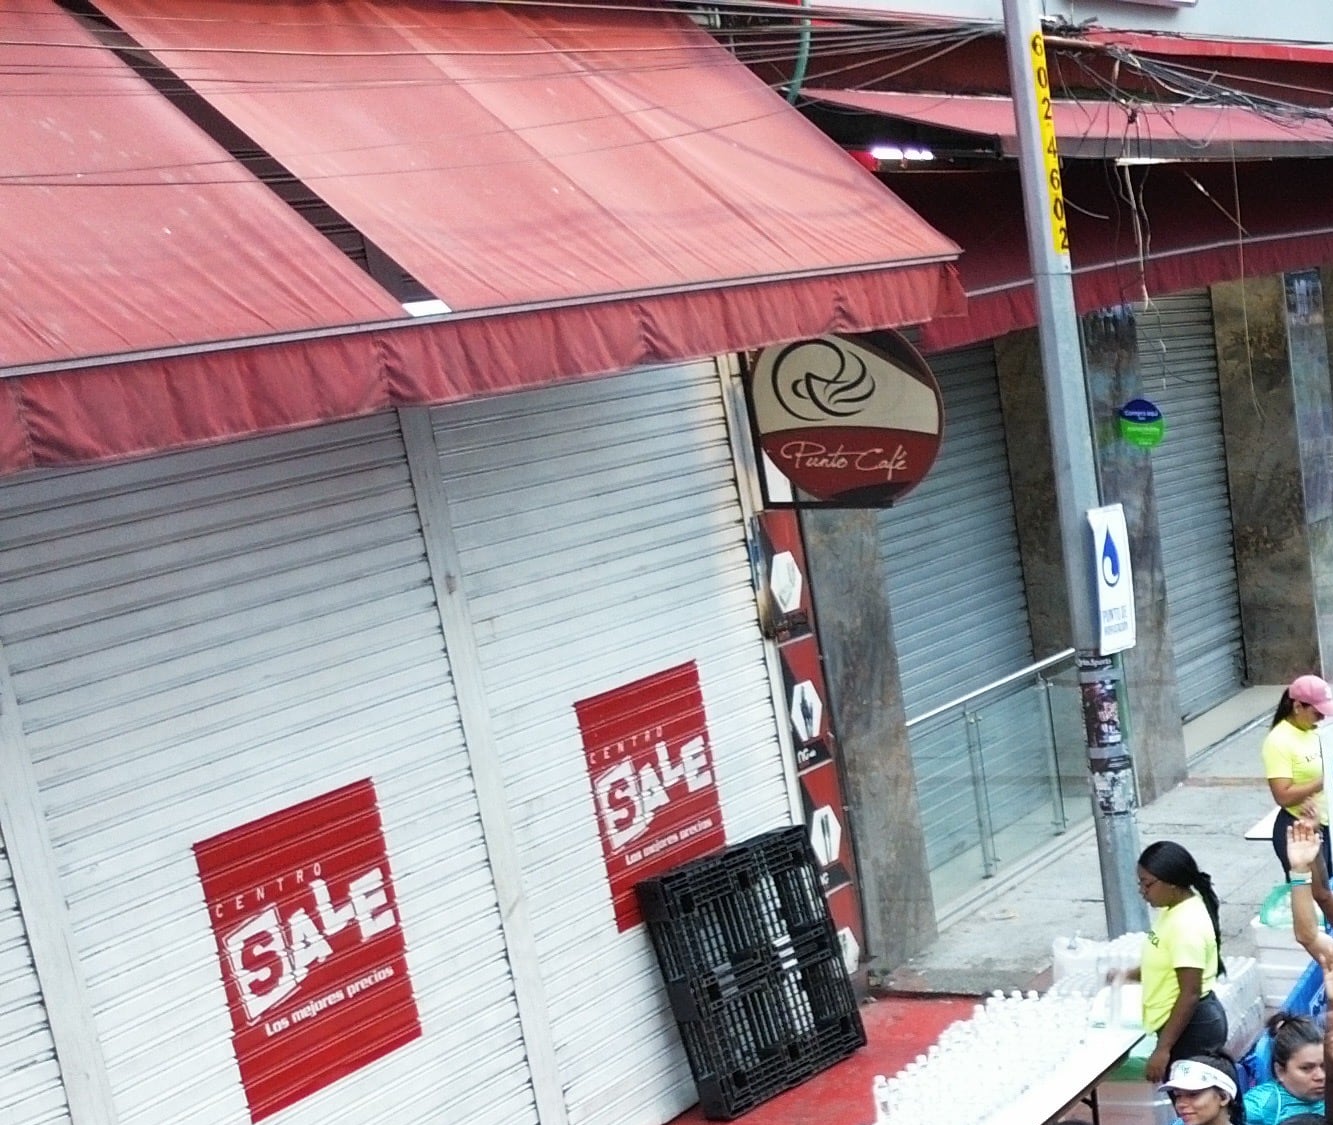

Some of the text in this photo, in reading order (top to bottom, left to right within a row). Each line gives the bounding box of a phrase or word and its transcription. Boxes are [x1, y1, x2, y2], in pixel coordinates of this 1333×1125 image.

[781, 441, 908, 480] Punto Café
[590, 726, 663, 764] CENTRO
[594, 735, 714, 854] SALE
[625, 819, 713, 866] Los mejores precios
[215, 862, 321, 918] CENTRO
[223, 867, 397, 1027] SALE
[265, 965, 394, 1038] Los mejores precios
